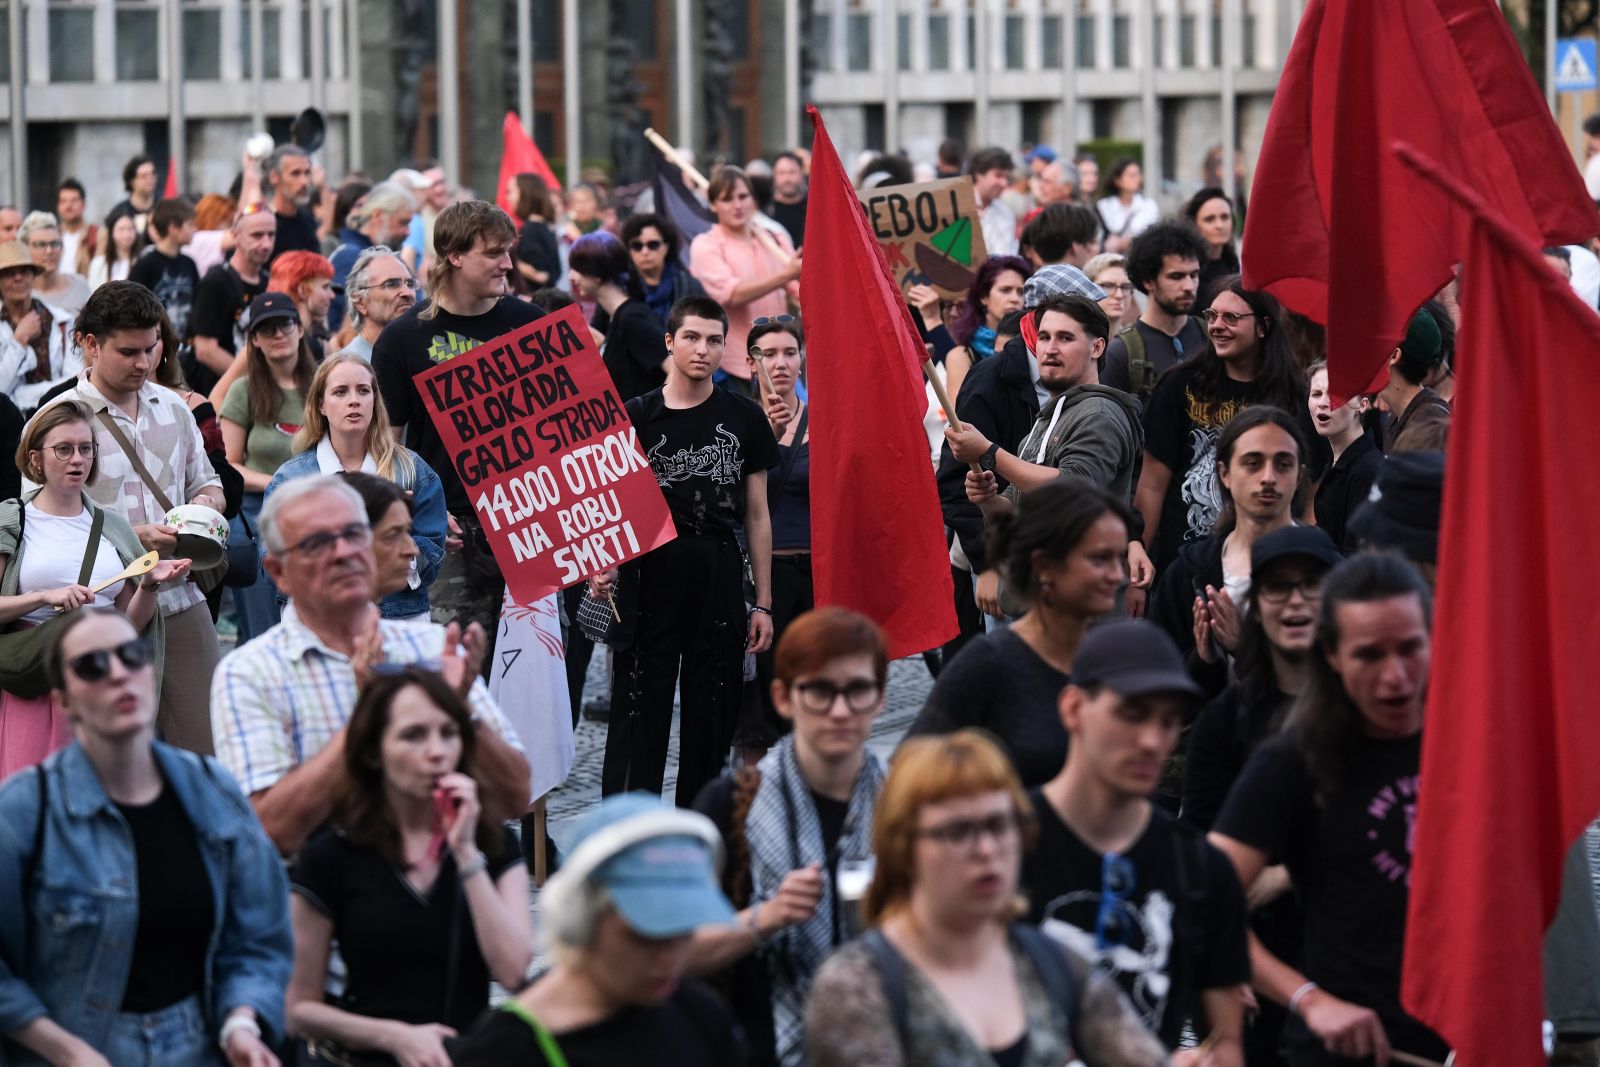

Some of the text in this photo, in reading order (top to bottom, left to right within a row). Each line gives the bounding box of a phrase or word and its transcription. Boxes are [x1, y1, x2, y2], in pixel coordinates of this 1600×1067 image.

[860, 190, 959, 238] EBOJ
[425, 319, 585, 412] IZRAELSKA
[450, 365, 579, 443] BLOKADA
[455, 390, 627, 487] GAZO STRADA
[475, 465, 561, 532] 14.000
[560, 426, 649, 496] OTROK
[507, 489, 622, 563] NA ROBU
[552, 520, 641, 585] SMRTI
